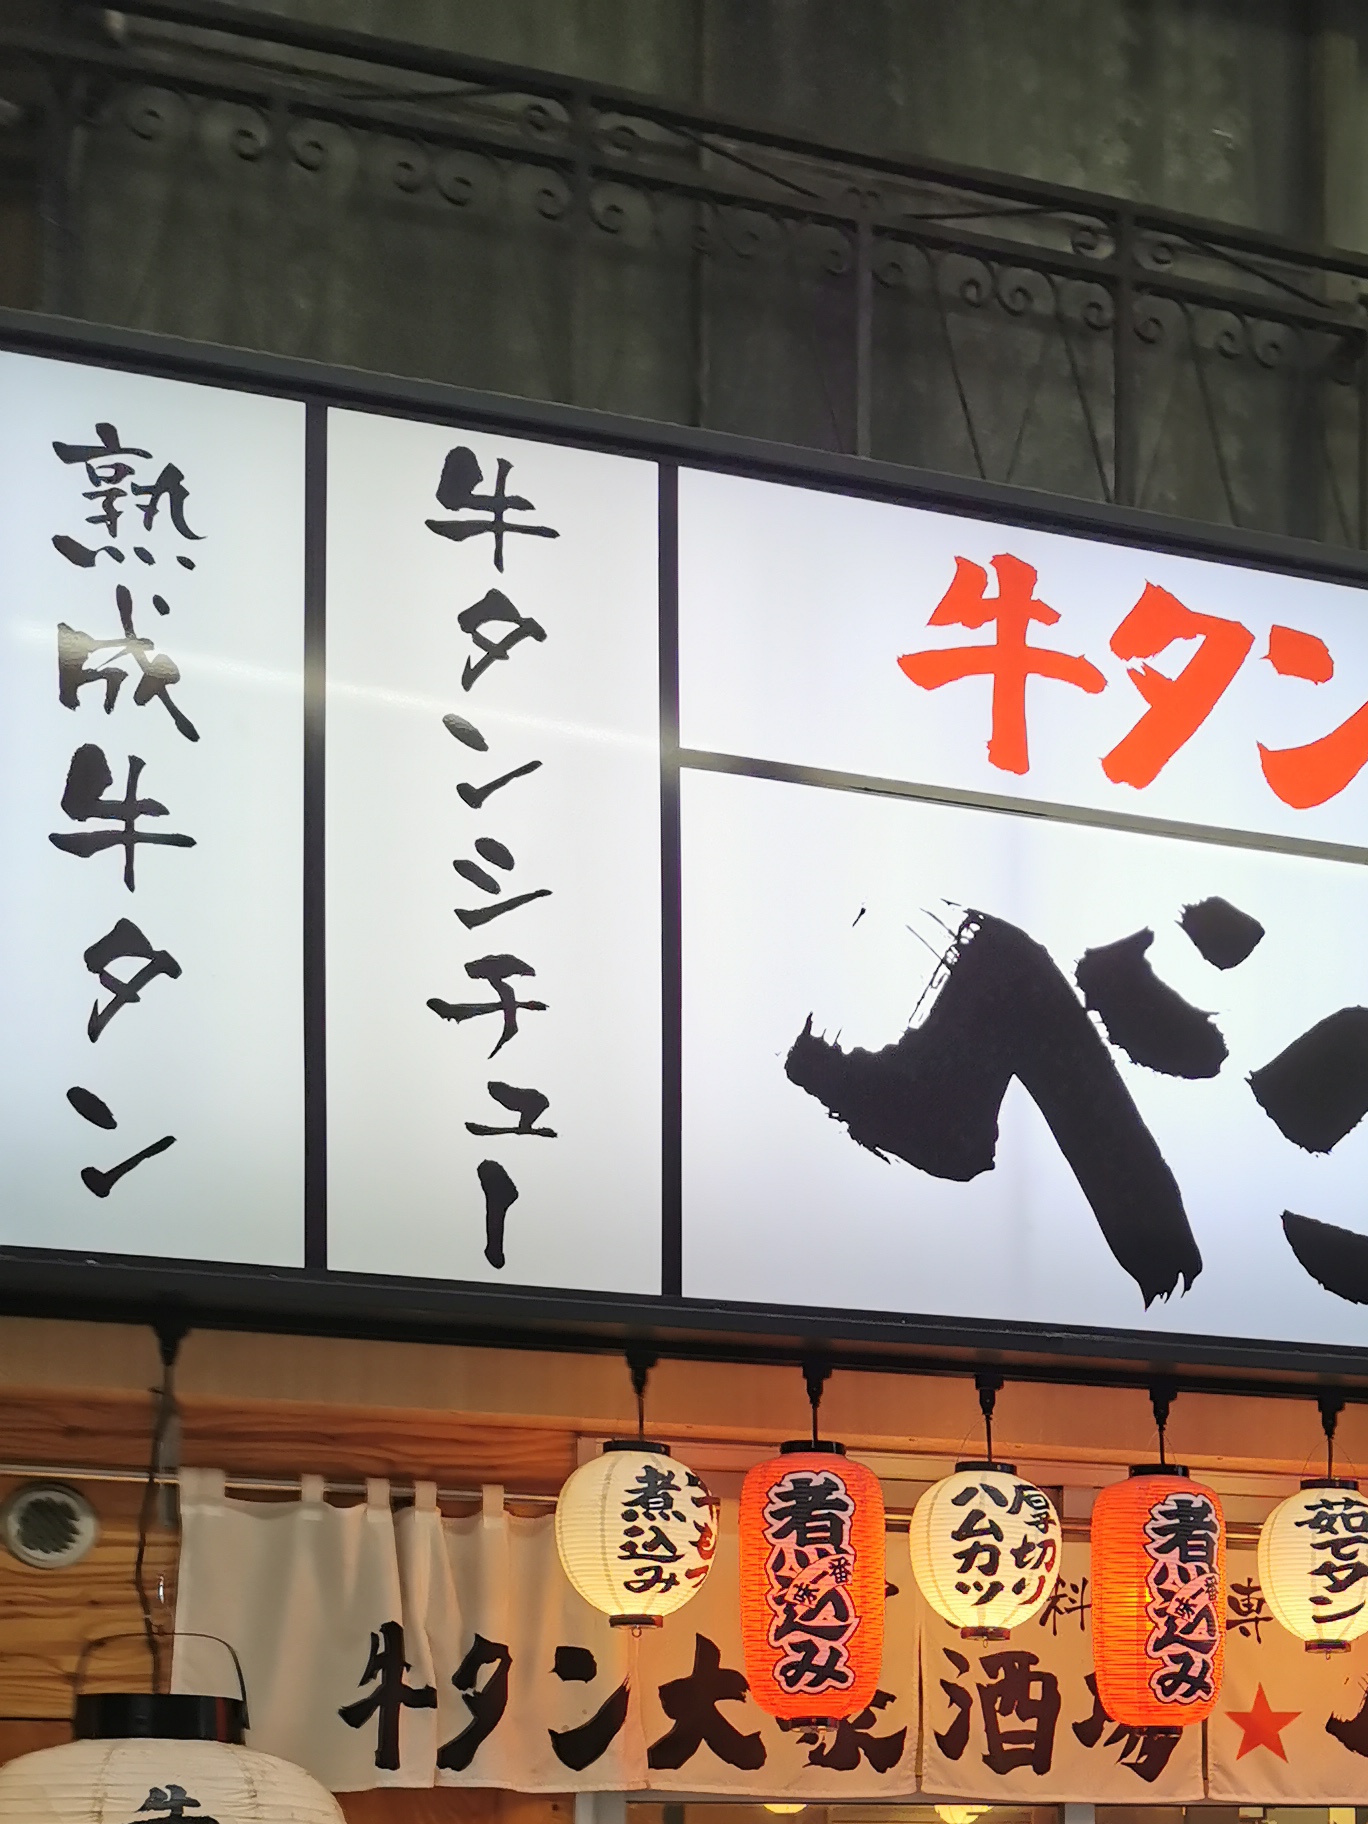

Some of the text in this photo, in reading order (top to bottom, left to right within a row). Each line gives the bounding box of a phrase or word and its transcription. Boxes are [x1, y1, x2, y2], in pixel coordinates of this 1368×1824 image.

[48, 422, 208, 1198] 熟成牛タン
[425, 446, 560, 1270] 牛タンシチュー
[617, 1465, 687, 1594] 煮込み
[951, 1483, 1009, 1607] ハムカツ
[1006, 1484, 1058, 1606] 厚切り
